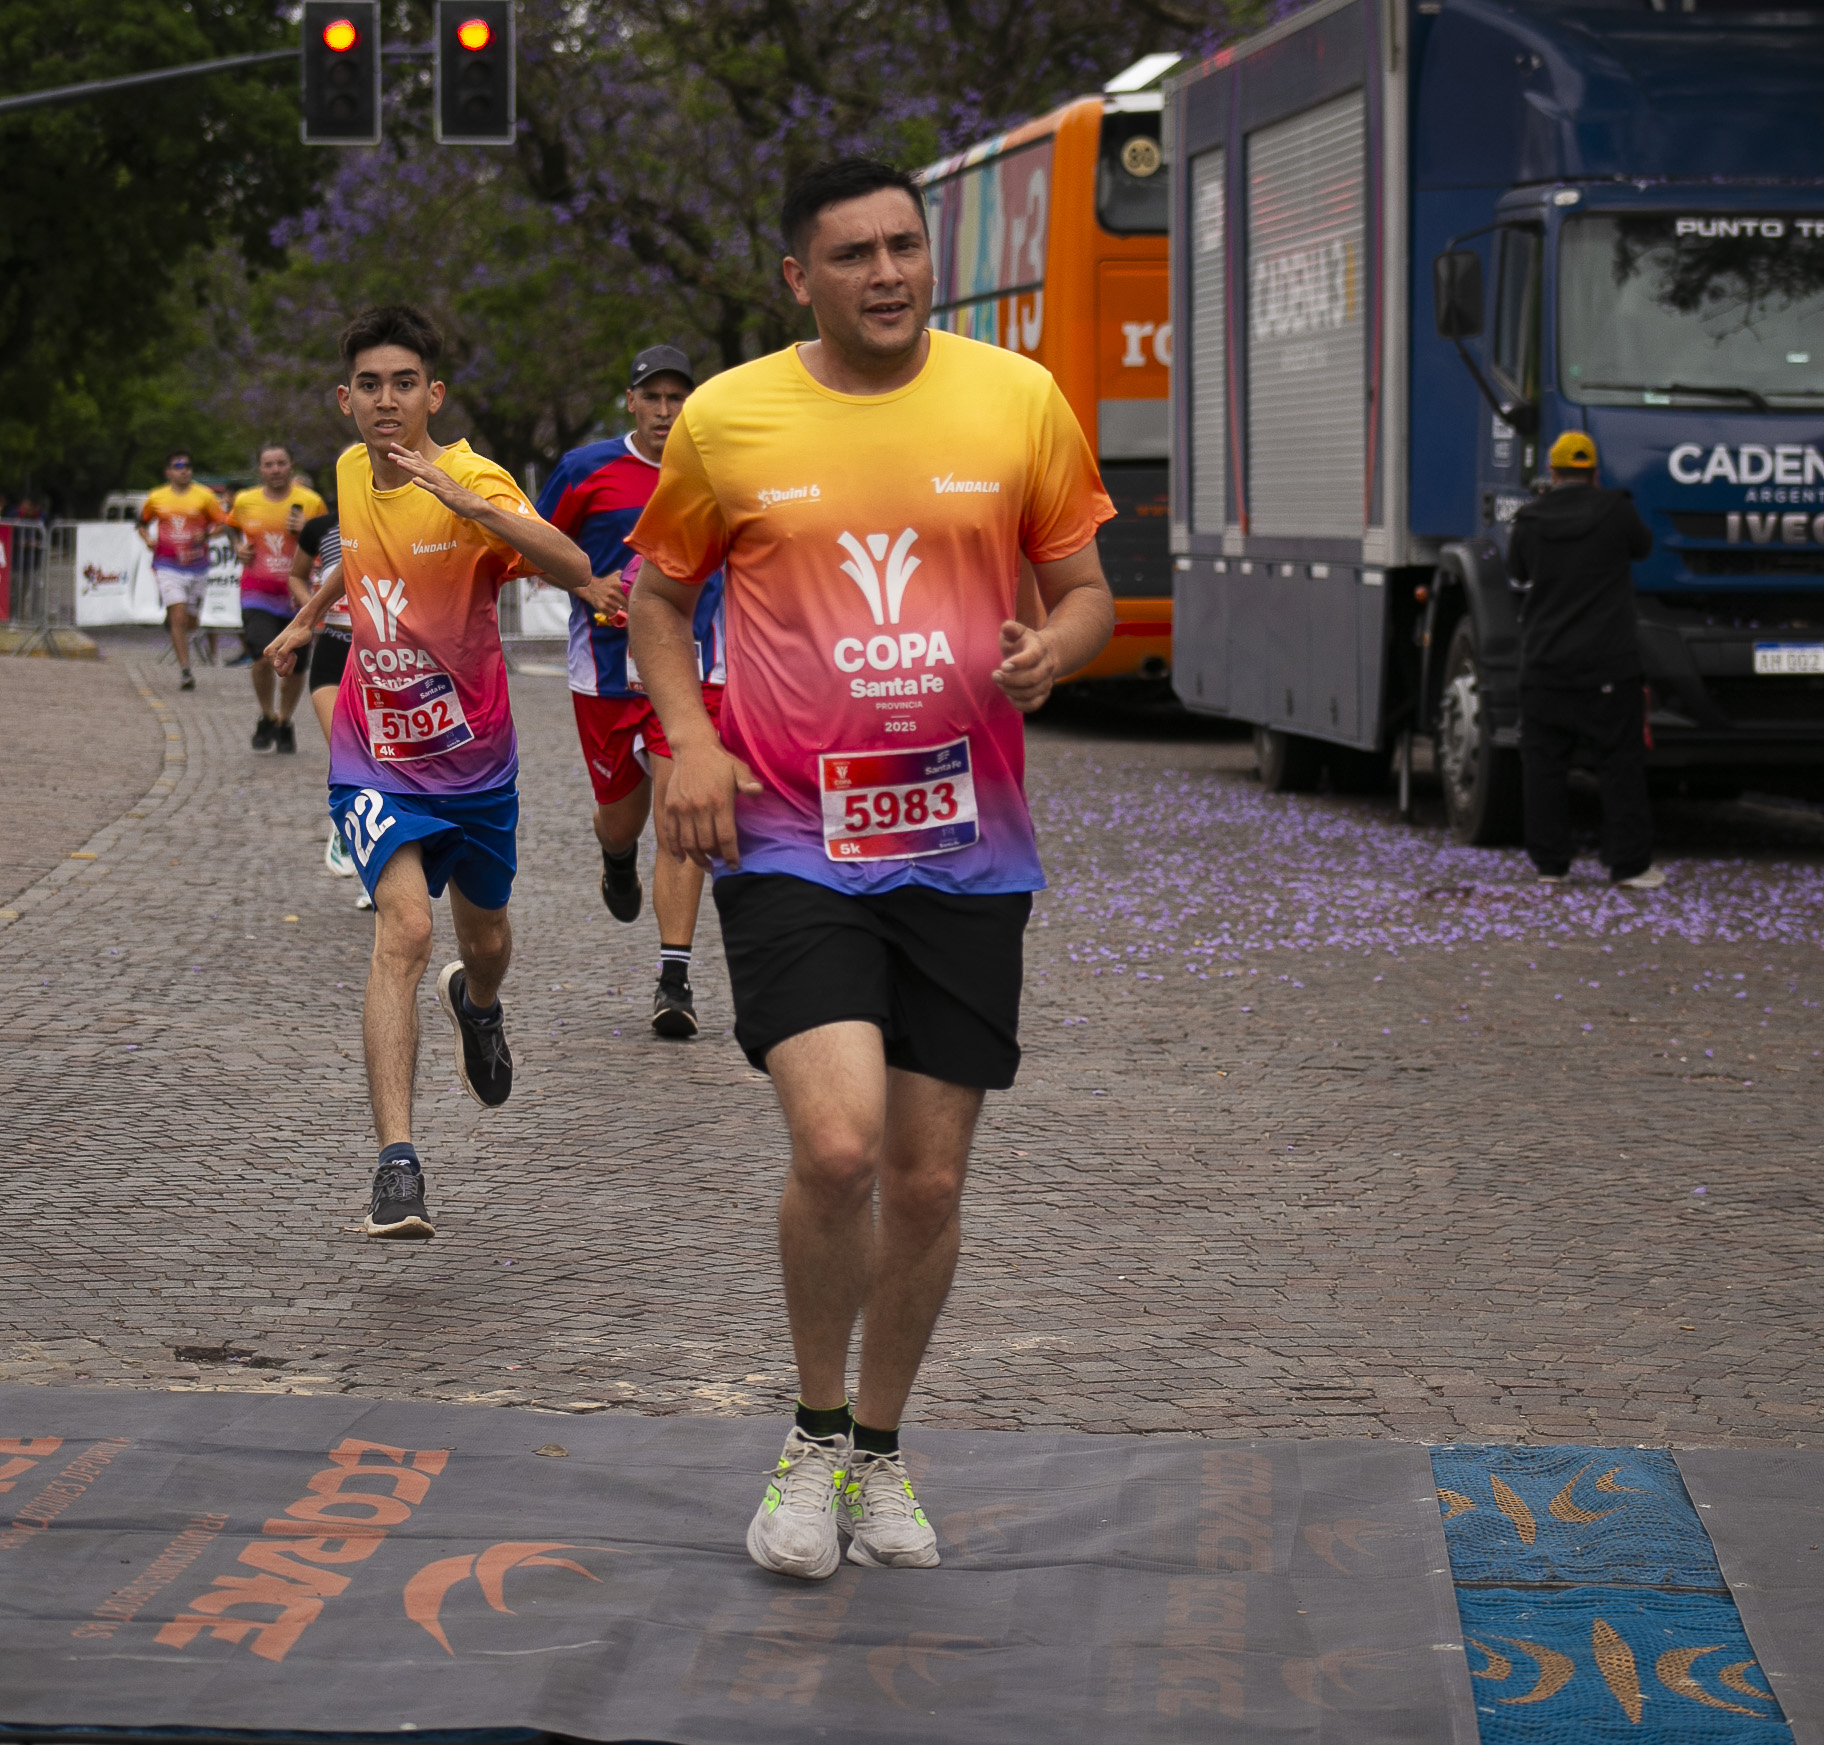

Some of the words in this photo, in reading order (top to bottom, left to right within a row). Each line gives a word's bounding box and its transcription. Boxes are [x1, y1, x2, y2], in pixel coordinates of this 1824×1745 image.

[1676, 218, 1784, 237] PUNTO
[810, 484, 821, 497] 6
[930, 472, 1000, 494] VANDALIA
[352, 539, 359, 549] 6
[411, 539, 457, 555] VANDALIA
[834, 631, 955, 673] COPA
[359, 648, 438, 673] COPA
[420, 687, 438, 699] Santa
[850, 677, 918, 698] Santa
[921, 674, 944, 694] Fe
[876, 701, 923, 710] PROVINCIA
[382, 700, 454, 740] 5792
[885, 721, 917, 732] 2025
[380, 745, 395, 756] 4k
[925, 764, 951, 775] Santa
[952, 760, 962, 769] Fe
[845, 782, 958, 833] 5983
[344, 788, 396, 868] 22
[840, 843, 861, 855] 5k
